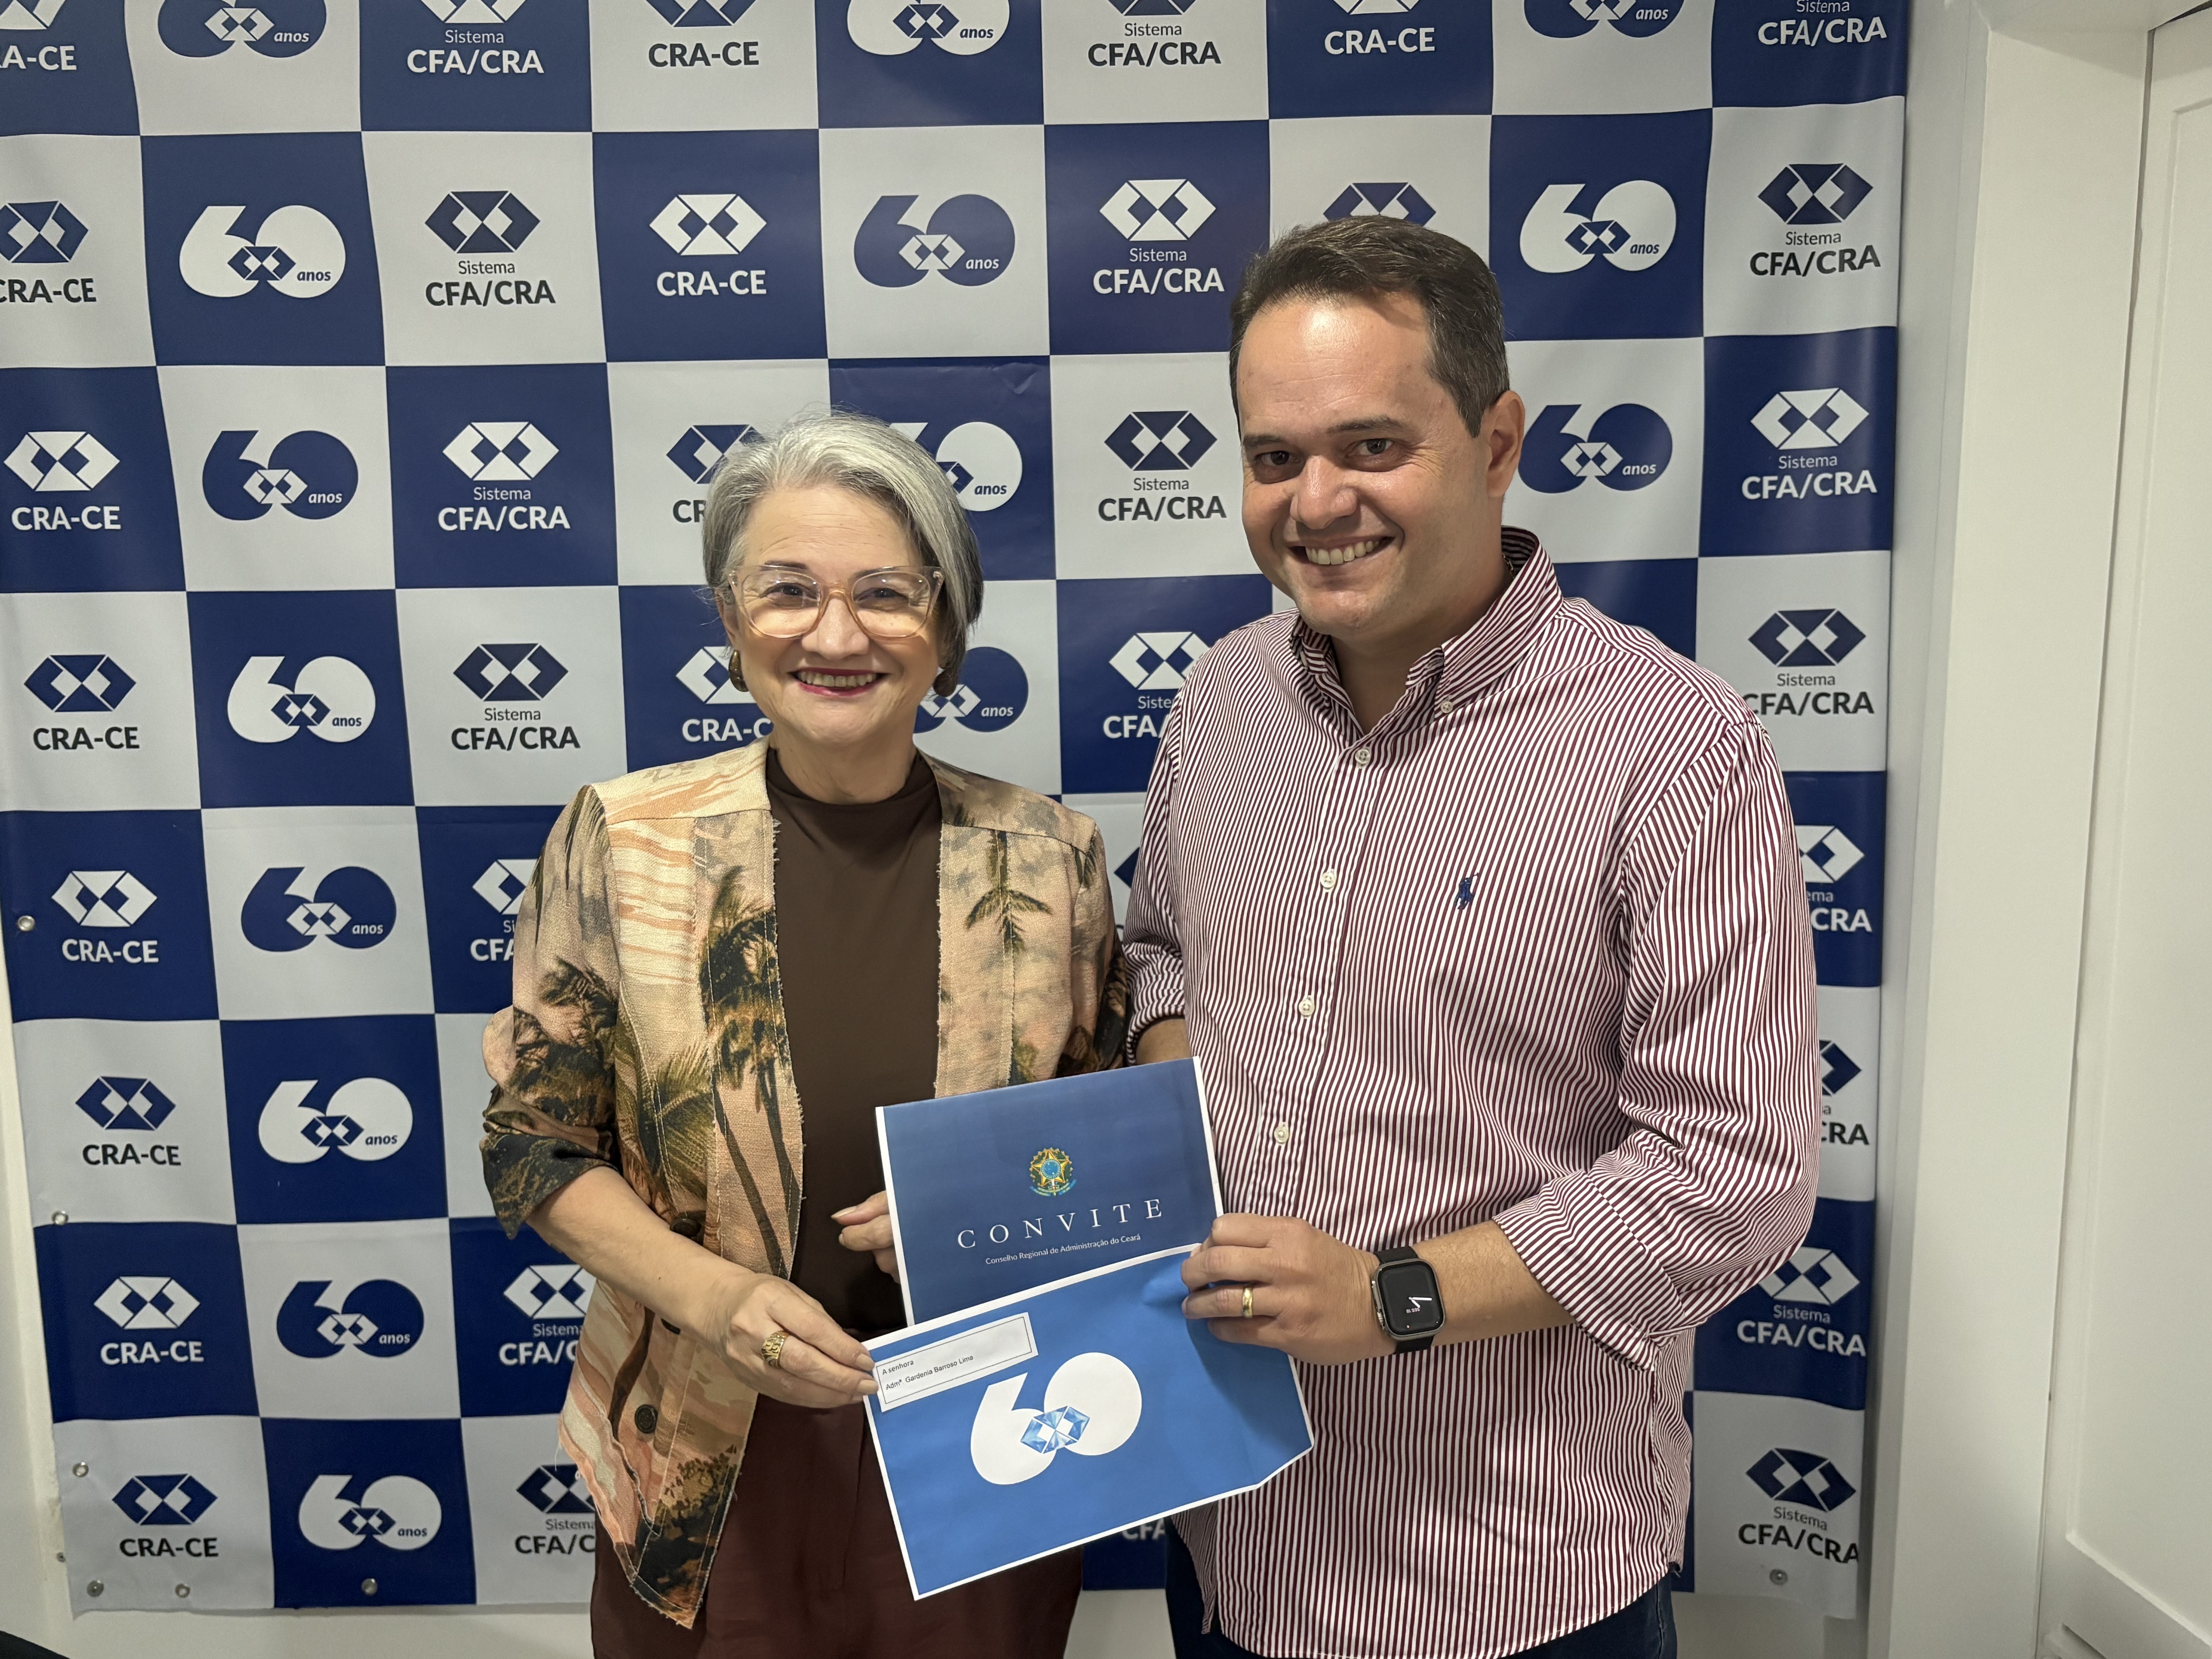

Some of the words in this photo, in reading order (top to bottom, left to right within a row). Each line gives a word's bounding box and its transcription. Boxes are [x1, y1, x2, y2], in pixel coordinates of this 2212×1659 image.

[1636, 9, 1669, 20] anos
[1796, 0, 1850, 13] Sistema
[274, 32, 309, 42] anos
[445, 30, 503, 43] Sistema
[960, 28, 994, 38] anos
[1125, 23, 1182, 36] Sistema
[1758, 17, 1887, 46] CFA/CRA
[1325, 28, 1434, 54] CRA-CE
[0, 45, 77, 70] A-CE
[408, 50, 544, 74] CFA/CRA
[649, 41, 759, 67] CRA-CE
[1088, 42, 1221, 67] CFA/CRA
[1786, 232, 1841, 245] Sistema
[1130, 248, 1186, 261] Sistema
[1630, 244, 1660, 254] anos
[459, 261, 515, 274] Sistema
[965, 259, 999, 269] anos
[1750, 245, 1881, 276] CFA/CRA
[297, 271, 331, 281] anos
[657, 270, 766, 296] CRA-CE
[1094, 268, 1224, 294] CFA/CRA
[426, 280, 555, 306] CFA/CRA
[1622, 464, 1656, 475] anos
[1779, 455, 1837, 469] Sistema
[474, 487, 531, 500] Sistema
[974, 485, 1007, 495] anos
[1134, 478, 1188, 491] Sistema
[1742, 470, 1877, 499] CFA/CRA
[308, 493, 342, 503] anos
[1099, 496, 1226, 521] CFA/CRA
[12, 506, 121, 530] CRA-CE
[438, 506, 570, 531] CFA/CRA
[1777, 673, 1835, 686] Sistema
[981, 706, 1013, 717] anos
[1138, 696, 1174, 709] Siste
[332, 717, 362, 727] anos
[485, 708, 541, 721] Sistema
[682, 718, 772, 742] CRA-C
[1103, 715, 1170, 738] CFA/
[33, 727, 139, 750] CRA-CE
[452, 726, 580, 751] CFA/CRA
[352, 925, 383, 934] anos
[62, 939, 158, 963] CRA-CE
[365, 1135, 397, 1146] anos
[83, 1144, 181, 1166] CRA-CE
[958, 1199, 1161, 1249] CONVITE
[986, 1255, 1017, 1264] Conselho
[1019, 1248, 1048, 1259] Regional
[1060, 1239, 1109, 1252] Administração
[1121, 1233, 1141, 1243] Ceará
[1774, 1305, 1830, 1323] Sistema
[379, 1334, 410, 1344] anos
[533, 1324, 582, 1336] Sistem
[1738, 1321, 1865, 1356] CFA/CRA
[101, 1341, 203, 1364] CRA-CE
[499, 1340, 579, 1365] CFA/C
[888, 1360, 914, 1373] senhora
[905, 1370, 933, 1382] Gardenia
[934, 1362, 957, 1373] Barroso
[958, 1355, 974, 1364] Lima
[545, 1519, 594, 1530] Sistem
[1774, 1507, 1827, 1530] Sistema
[397, 1528, 428, 1537] anos
[120, 1538, 218, 1557] CRA-CE
[515, 1534, 596, 1554] CFA/C
[1738, 1524, 1858, 1564] CFA/CRA
